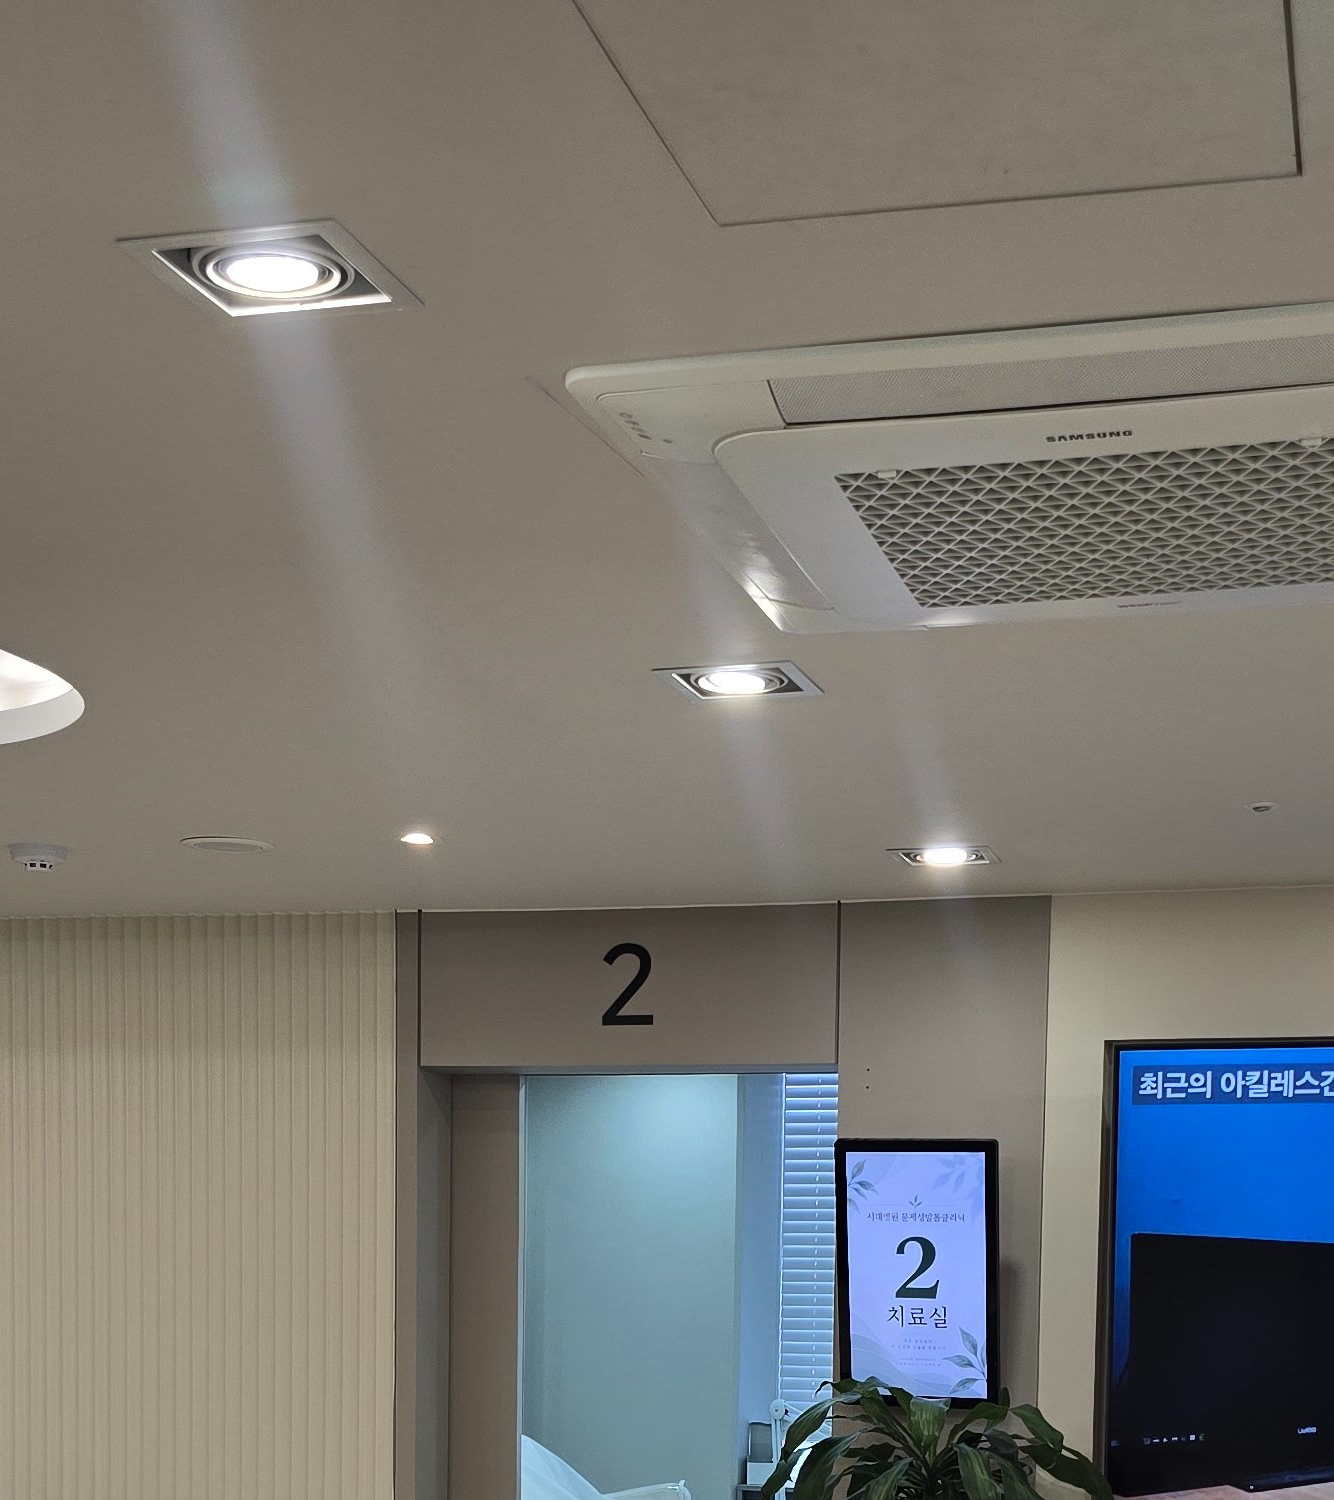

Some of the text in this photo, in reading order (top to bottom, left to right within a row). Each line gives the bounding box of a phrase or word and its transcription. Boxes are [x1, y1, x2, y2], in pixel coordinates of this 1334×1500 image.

[1046, 431, 1132, 442] SAMSUNG
[602, 943, 654, 1026] 2
[1138, 1071, 1212, 1100] 최근의
[895, 1236, 940, 1299] 2
[887, 1305, 948, 1329] 치료실
